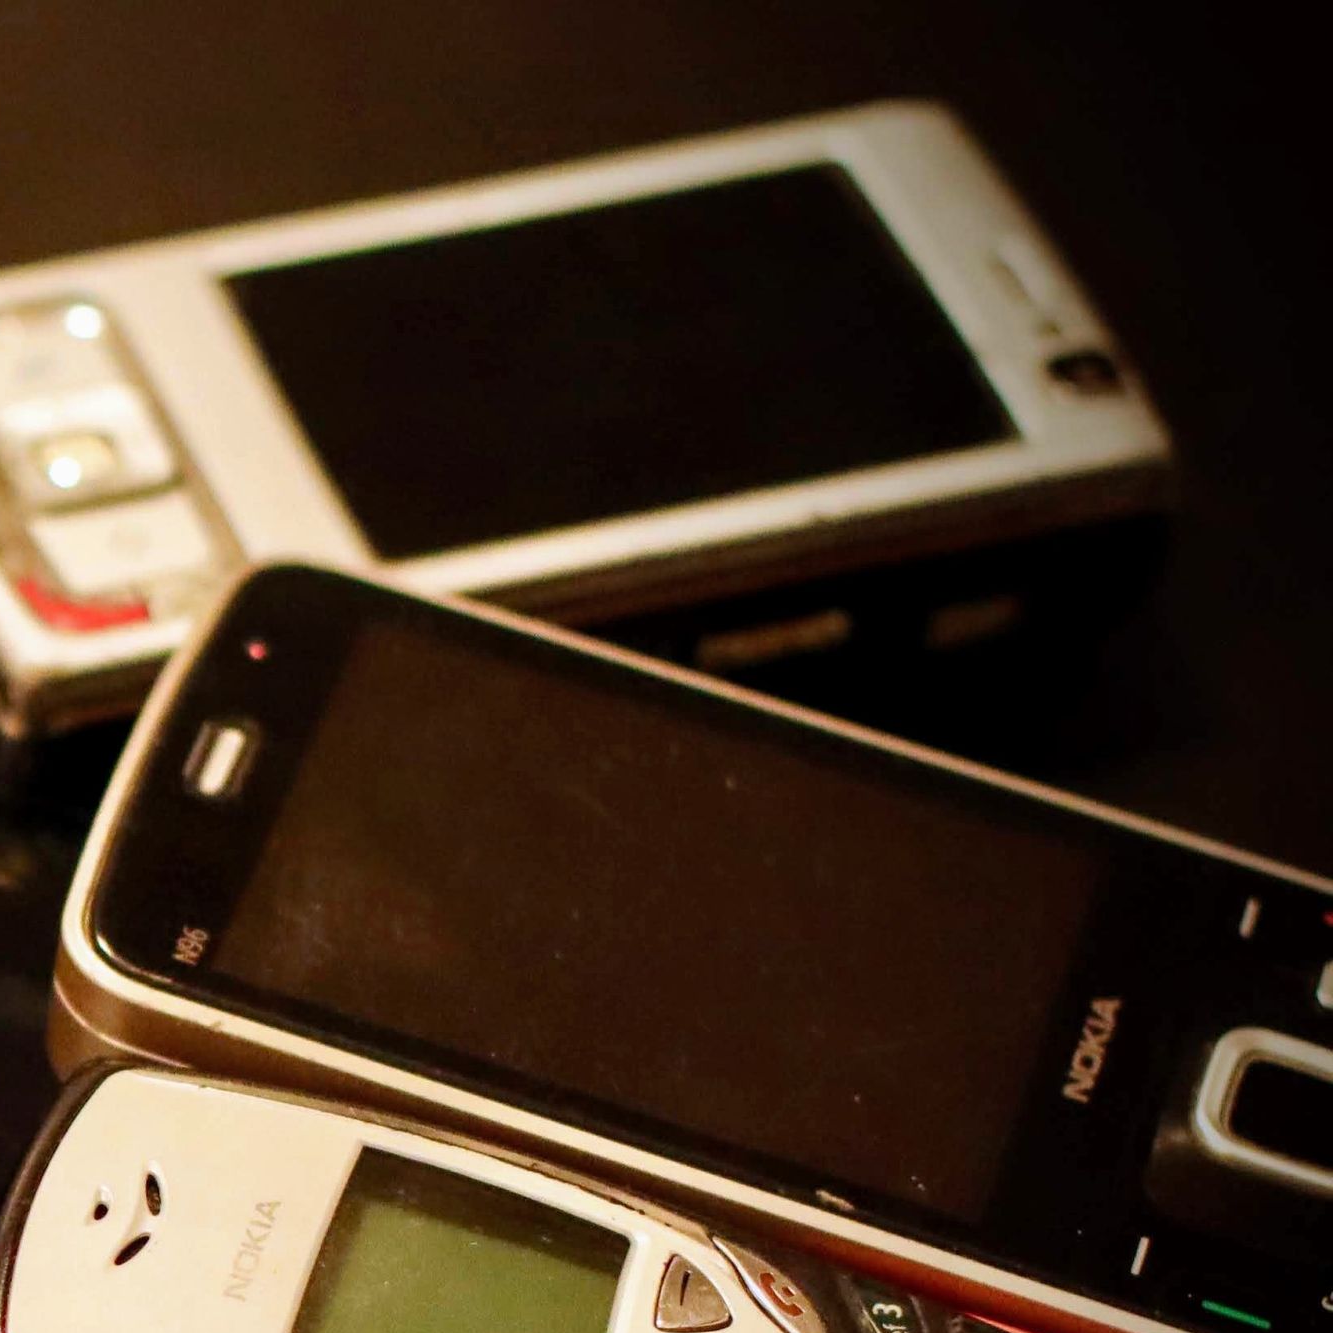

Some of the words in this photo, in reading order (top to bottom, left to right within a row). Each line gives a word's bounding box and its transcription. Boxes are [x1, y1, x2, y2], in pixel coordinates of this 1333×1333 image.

[172, 924, 209, 966] N96
[1062, 999, 1123, 1103] NOKIA
[221, 1200, 282, 1303] NOKIA
[871, 1302, 904, 1320] 3
